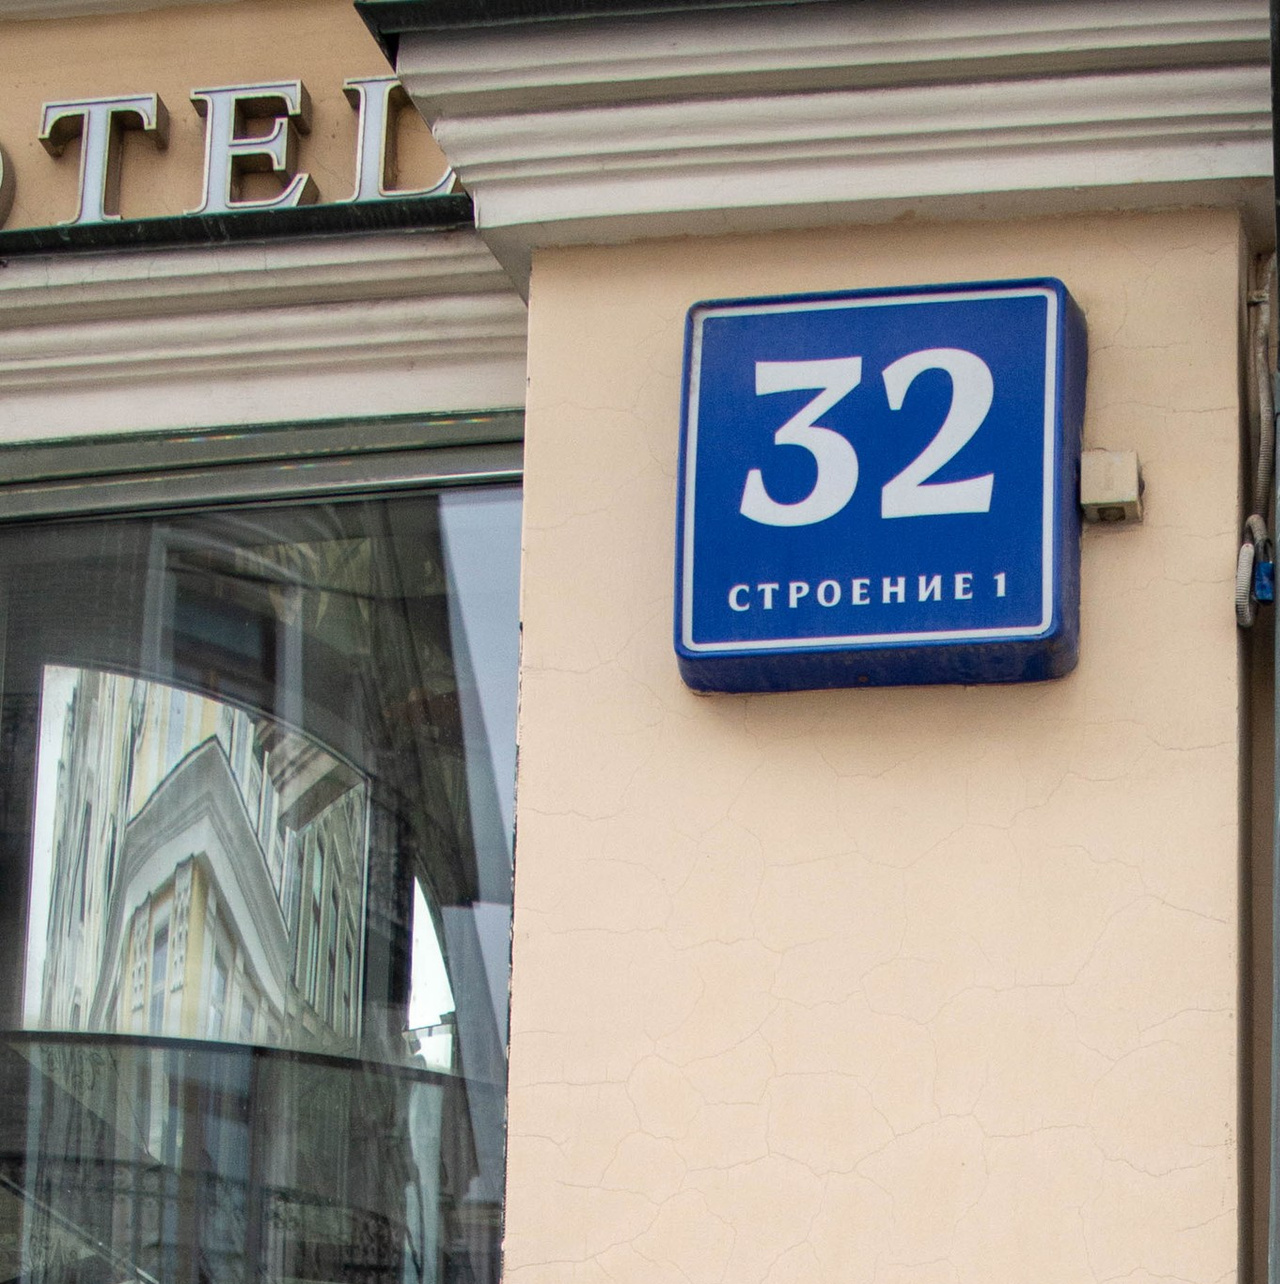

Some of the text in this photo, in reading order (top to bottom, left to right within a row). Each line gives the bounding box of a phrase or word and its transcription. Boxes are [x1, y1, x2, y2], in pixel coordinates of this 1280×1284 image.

[0, 75, 457, 227] TEL
[740, 347, 994, 528] 32
[727, 572, 1006, 612] СТРОЕНИЕ 1
